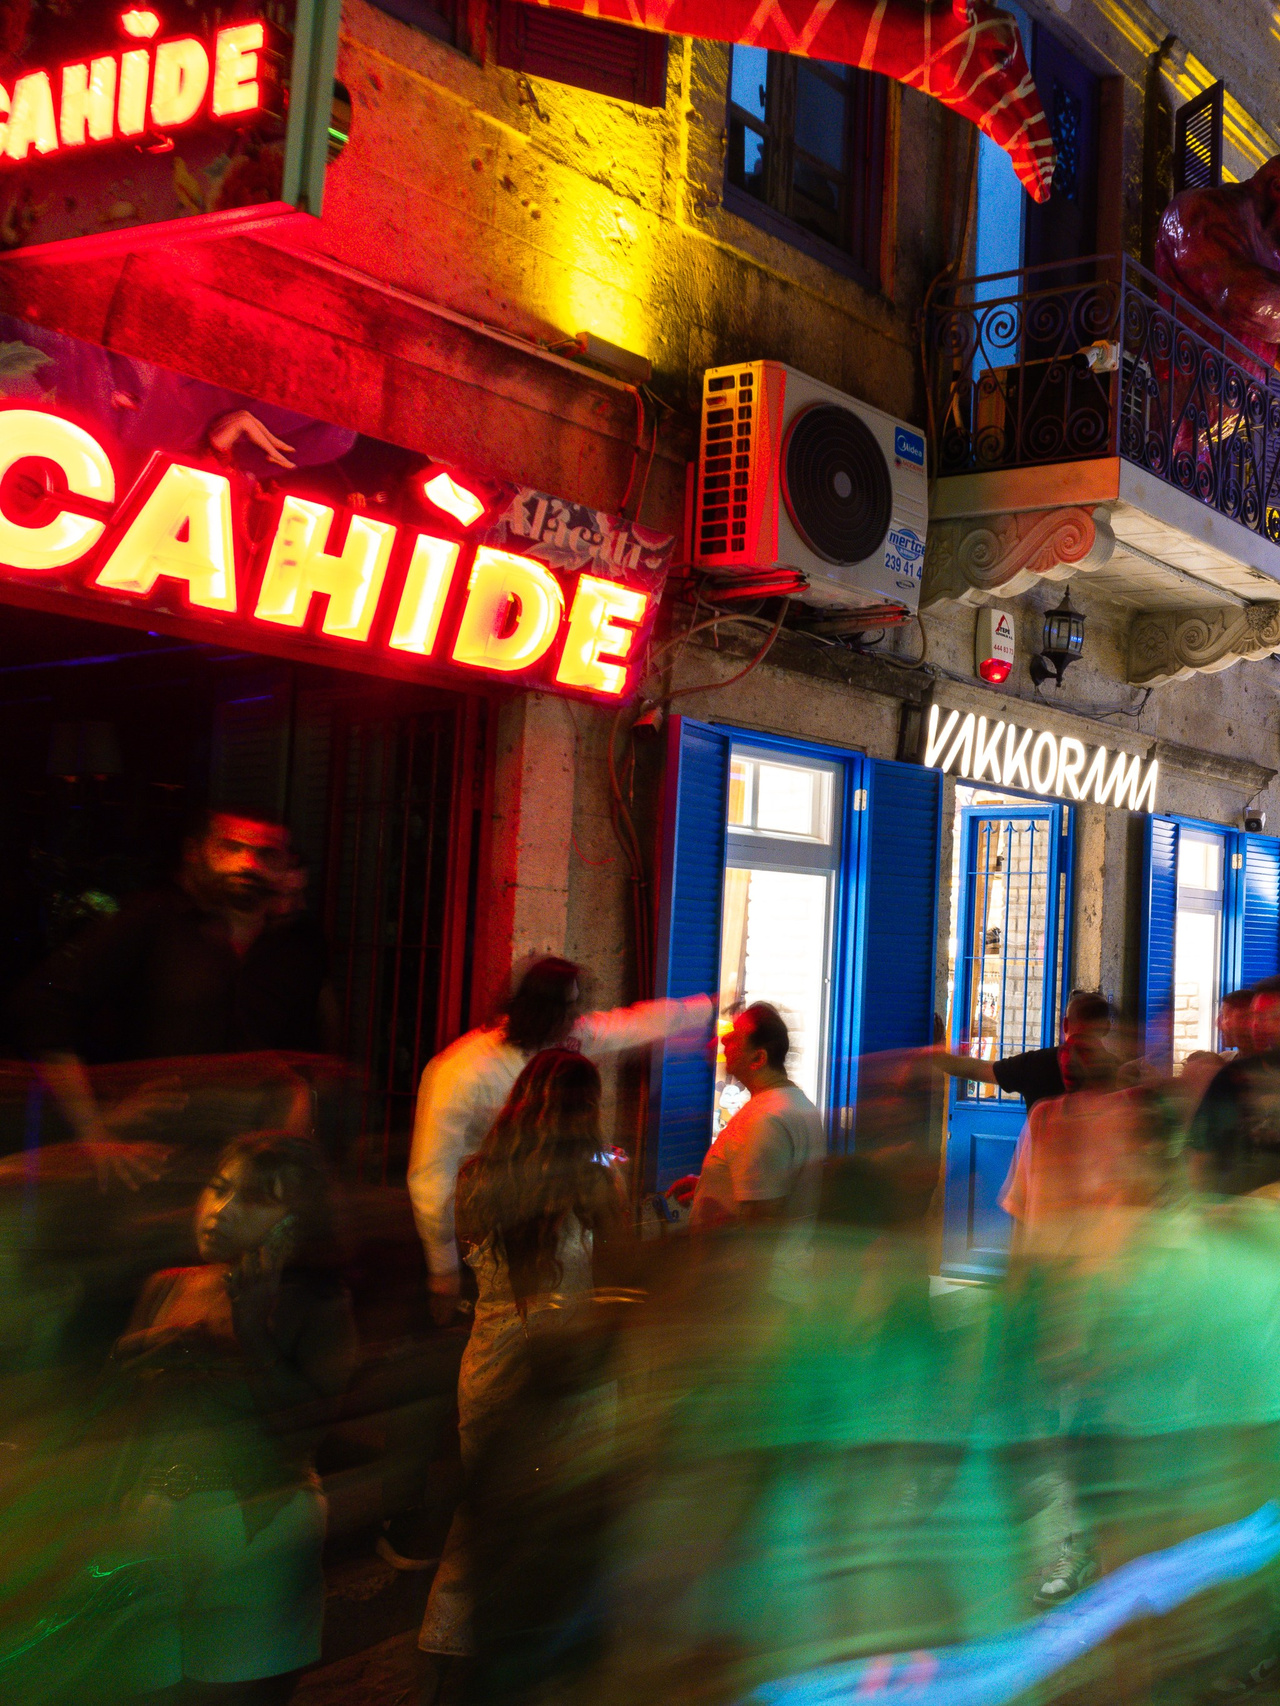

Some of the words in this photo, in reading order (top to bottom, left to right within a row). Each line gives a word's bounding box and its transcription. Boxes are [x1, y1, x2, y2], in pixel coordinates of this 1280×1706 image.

[902, 441, 922, 458] Midea
[885, 552, 901, 572] 239
[903, 561, 914, 577] 41
[924, 703, 1159, 814] VAKKORAMA
